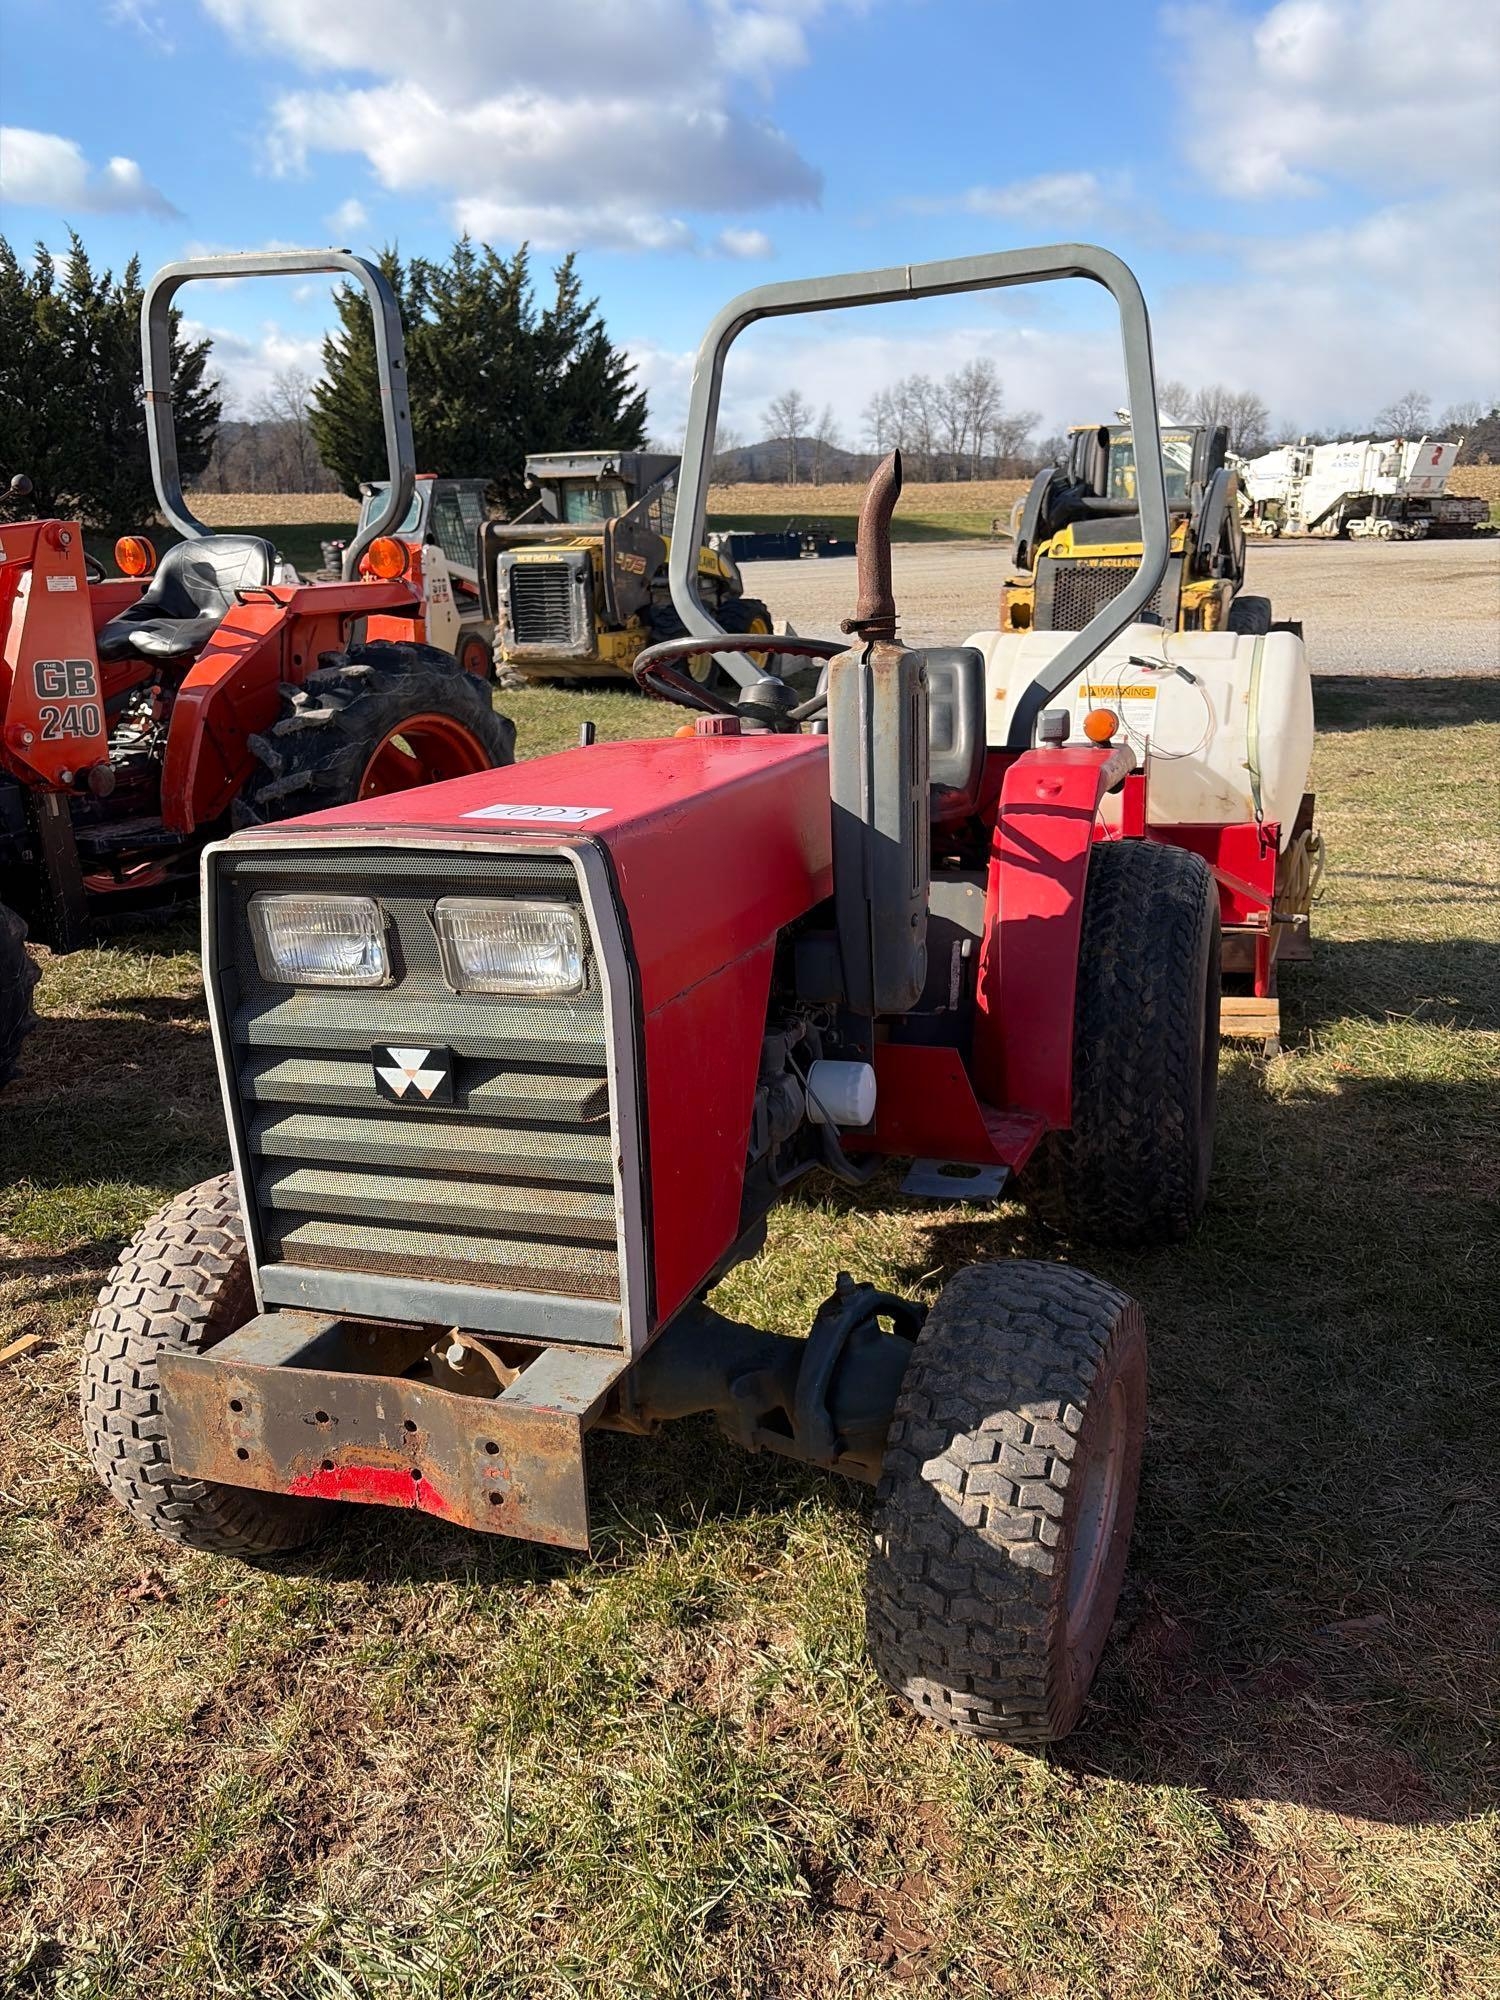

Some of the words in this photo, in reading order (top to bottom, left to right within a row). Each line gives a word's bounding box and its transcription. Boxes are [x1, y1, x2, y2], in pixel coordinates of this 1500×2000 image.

[34, 659, 96, 699] GB
[1097, 687, 1151, 697] WARNING
[39, 703, 101, 740] 240
